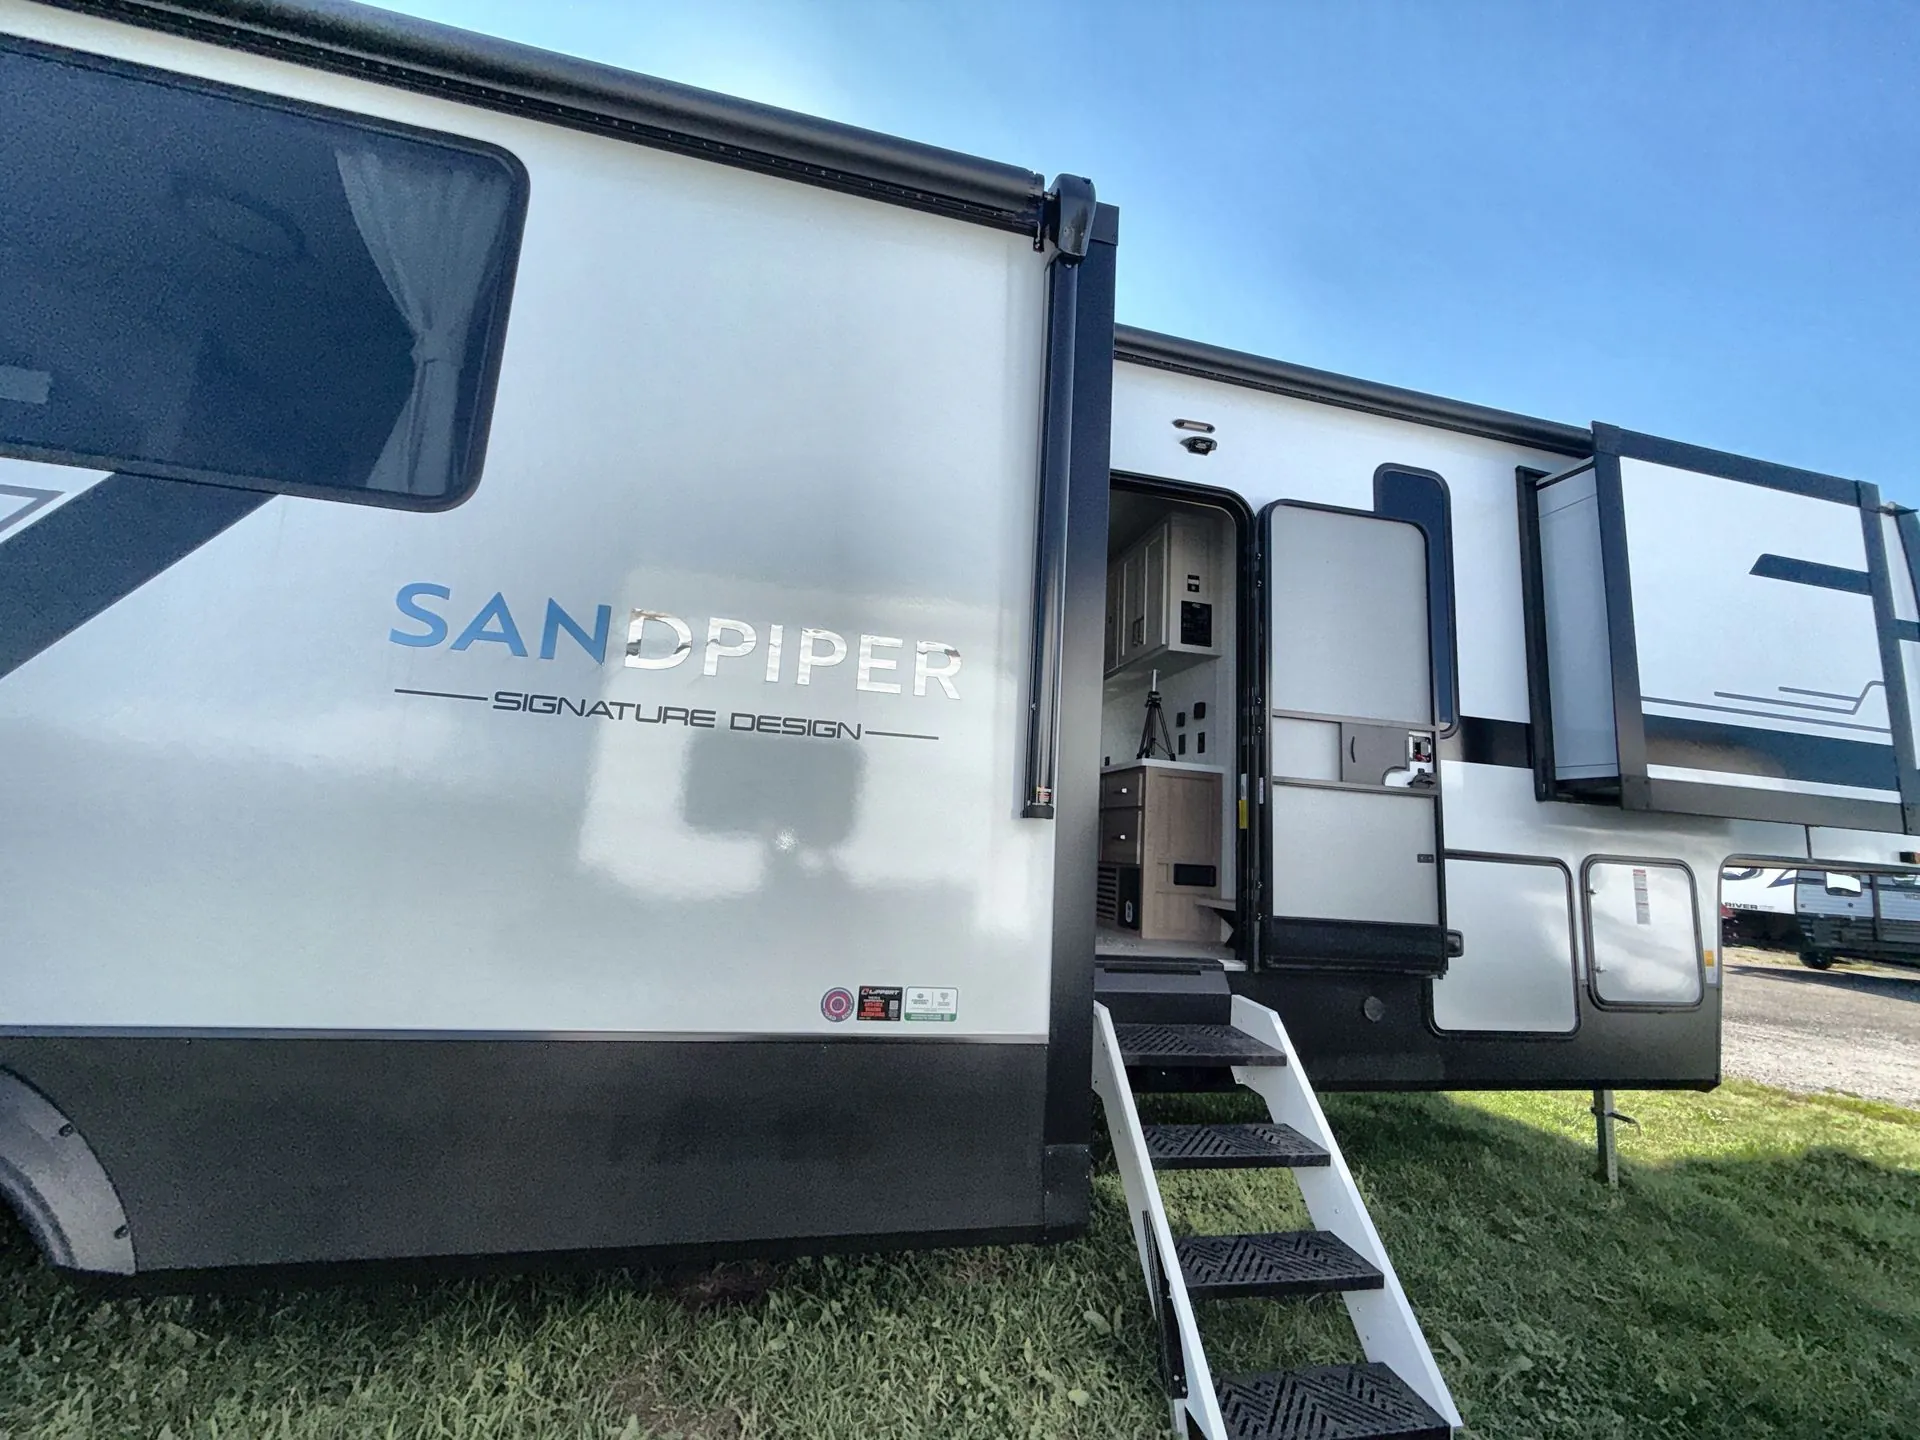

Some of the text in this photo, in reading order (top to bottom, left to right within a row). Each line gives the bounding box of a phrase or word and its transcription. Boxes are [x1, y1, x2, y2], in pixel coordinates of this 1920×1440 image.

[389, 582, 962, 700] SANDPIPER
[492, 690, 862, 741] SIGNATURE DESIGN
